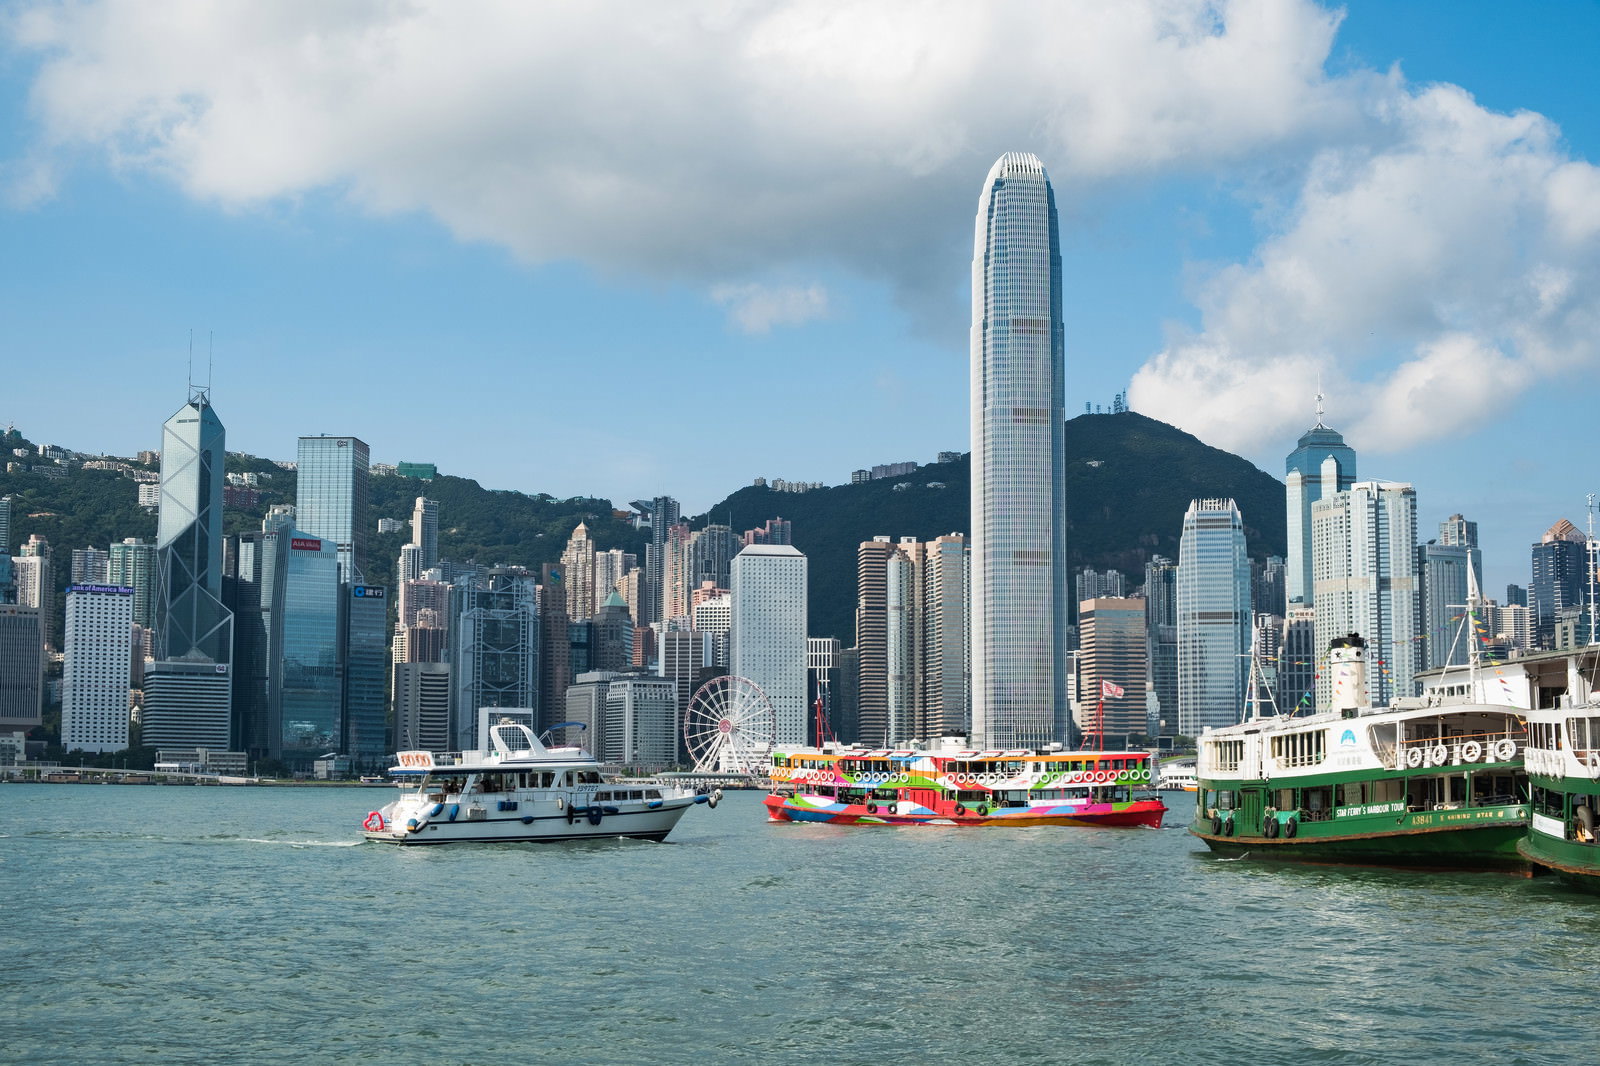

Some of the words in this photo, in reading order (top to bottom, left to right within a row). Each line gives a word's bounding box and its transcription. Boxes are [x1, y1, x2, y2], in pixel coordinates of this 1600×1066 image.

[1336, 808, 1347, 817] STAR
[1347, 805, 1366, 816] FERRY'S
[1366, 804, 1389, 814] HARBOUR
[1391, 802, 1404, 811] TOUR
